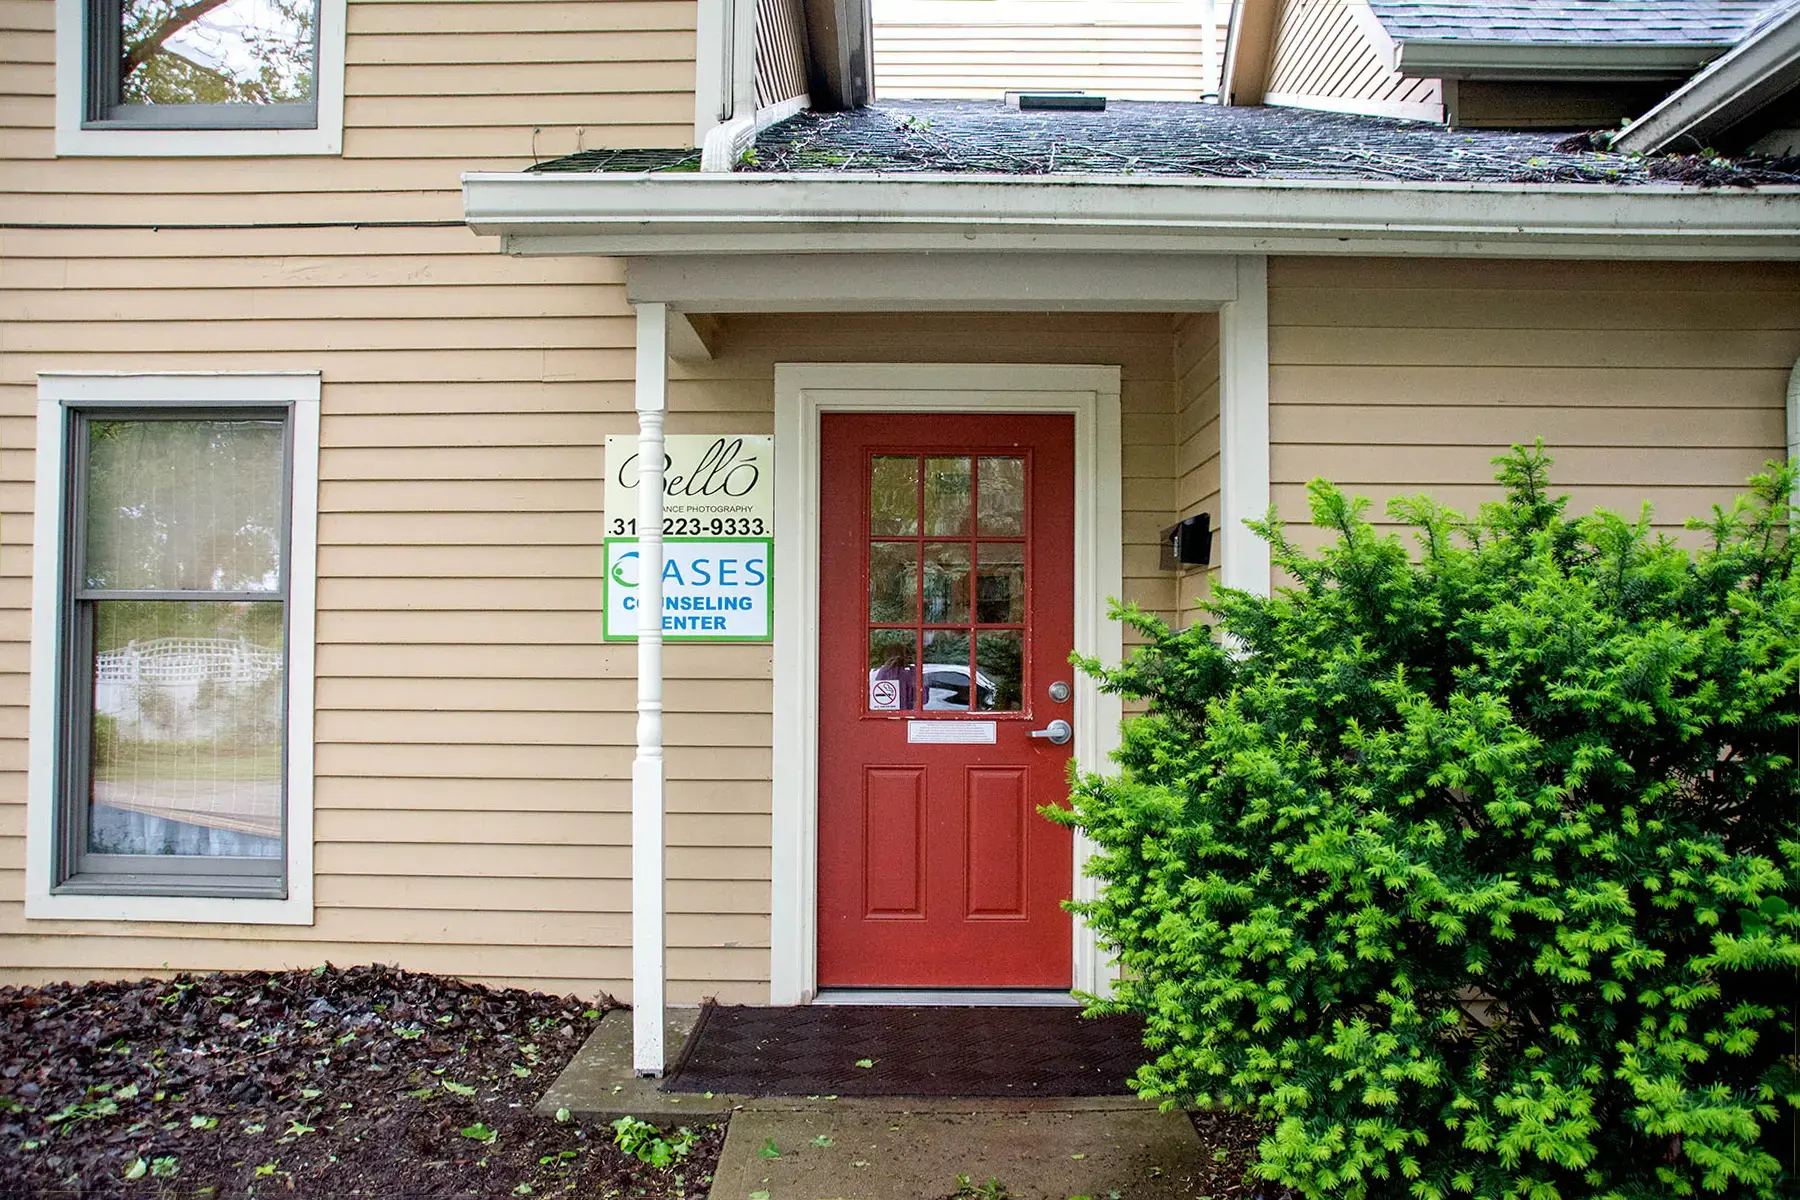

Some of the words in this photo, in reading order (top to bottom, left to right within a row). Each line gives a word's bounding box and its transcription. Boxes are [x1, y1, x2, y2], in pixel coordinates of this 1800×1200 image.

[686, 505, 753, 513] PHOTOGRAPHY
[613, 518, 764, 536] 31223-9333
[623, 596, 753, 611] CNSELING
[662, 616, 727, 630] ENTER
